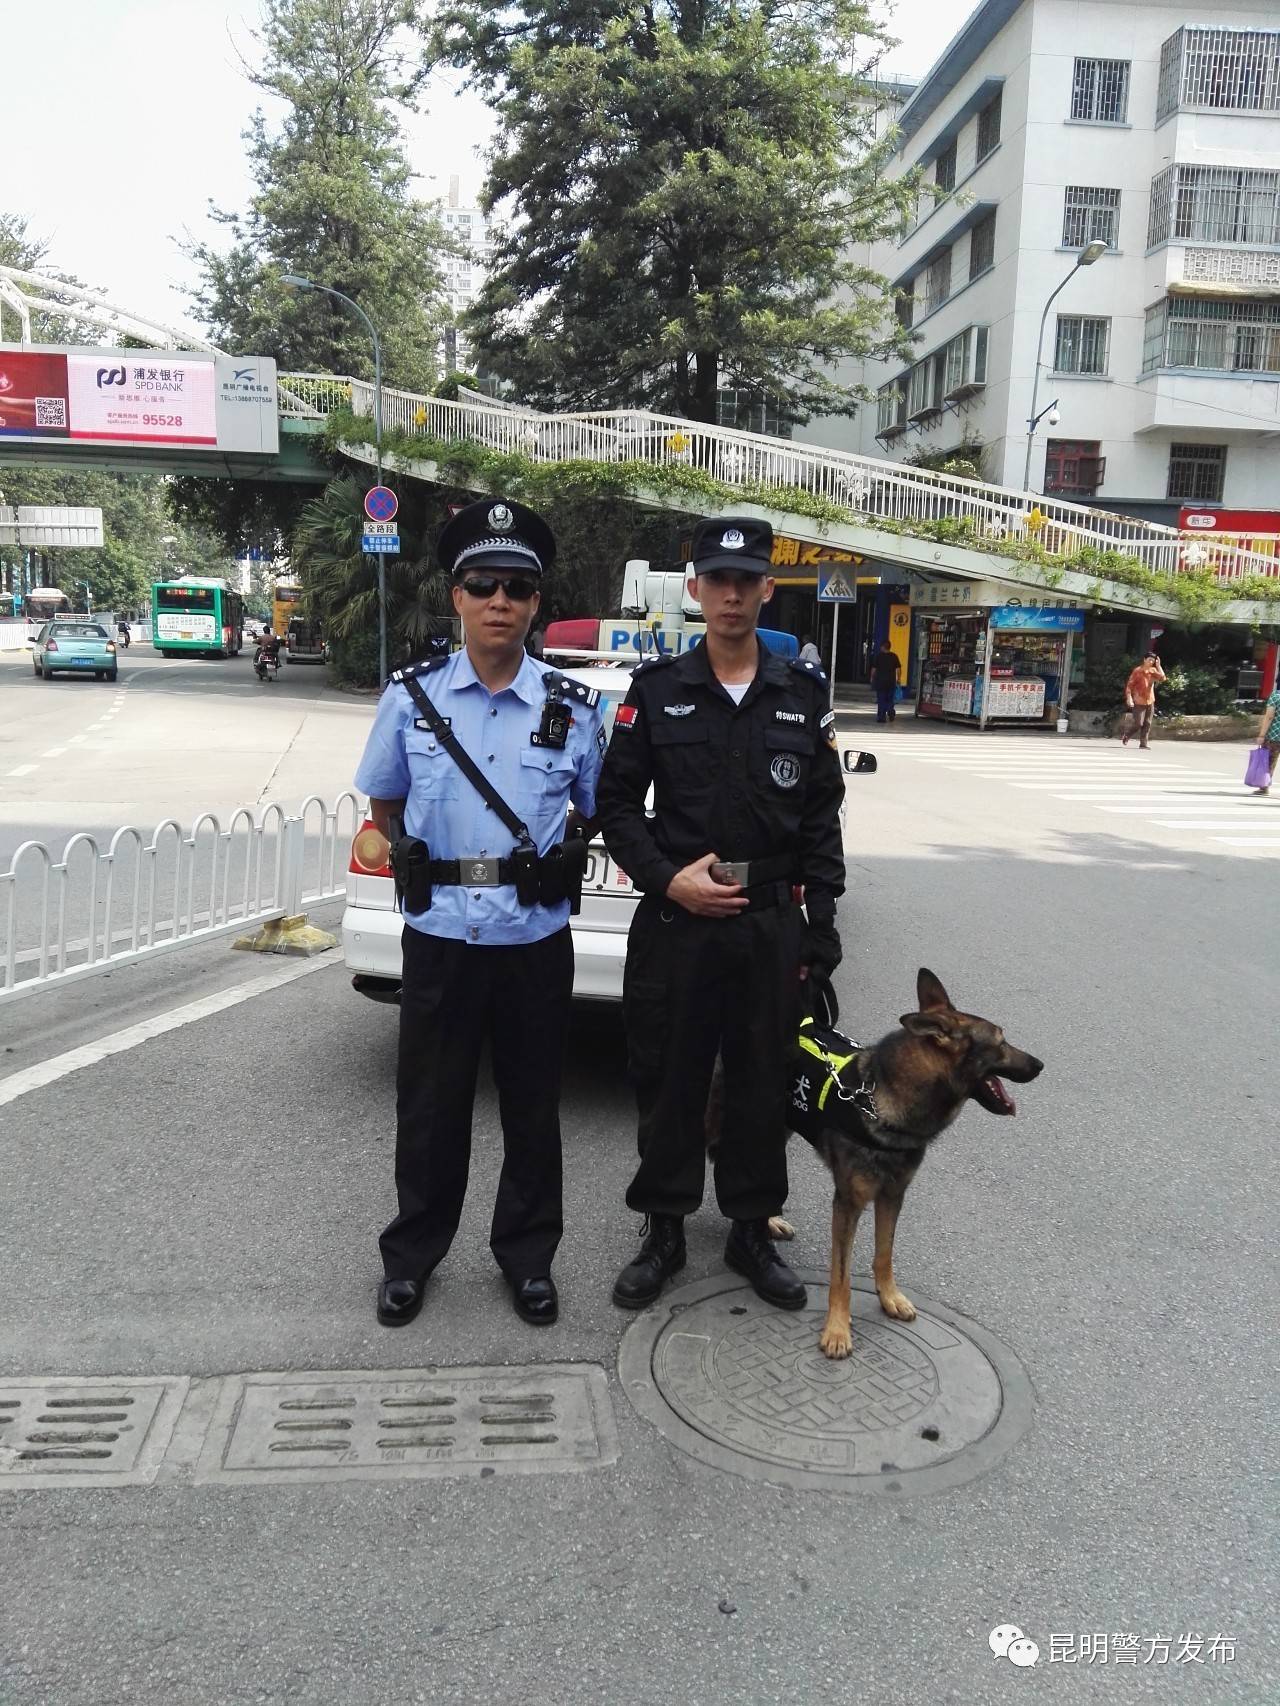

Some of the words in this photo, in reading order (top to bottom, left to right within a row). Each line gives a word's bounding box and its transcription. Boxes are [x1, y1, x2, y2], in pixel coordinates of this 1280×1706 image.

[133, 367, 184, 382] 浦发银行
[135, 381, 154, 390] SPD
[155, 382, 183, 392] BANK
[142, 414, 183, 427] 95528
[368, 524, 394, 533] 全路段
